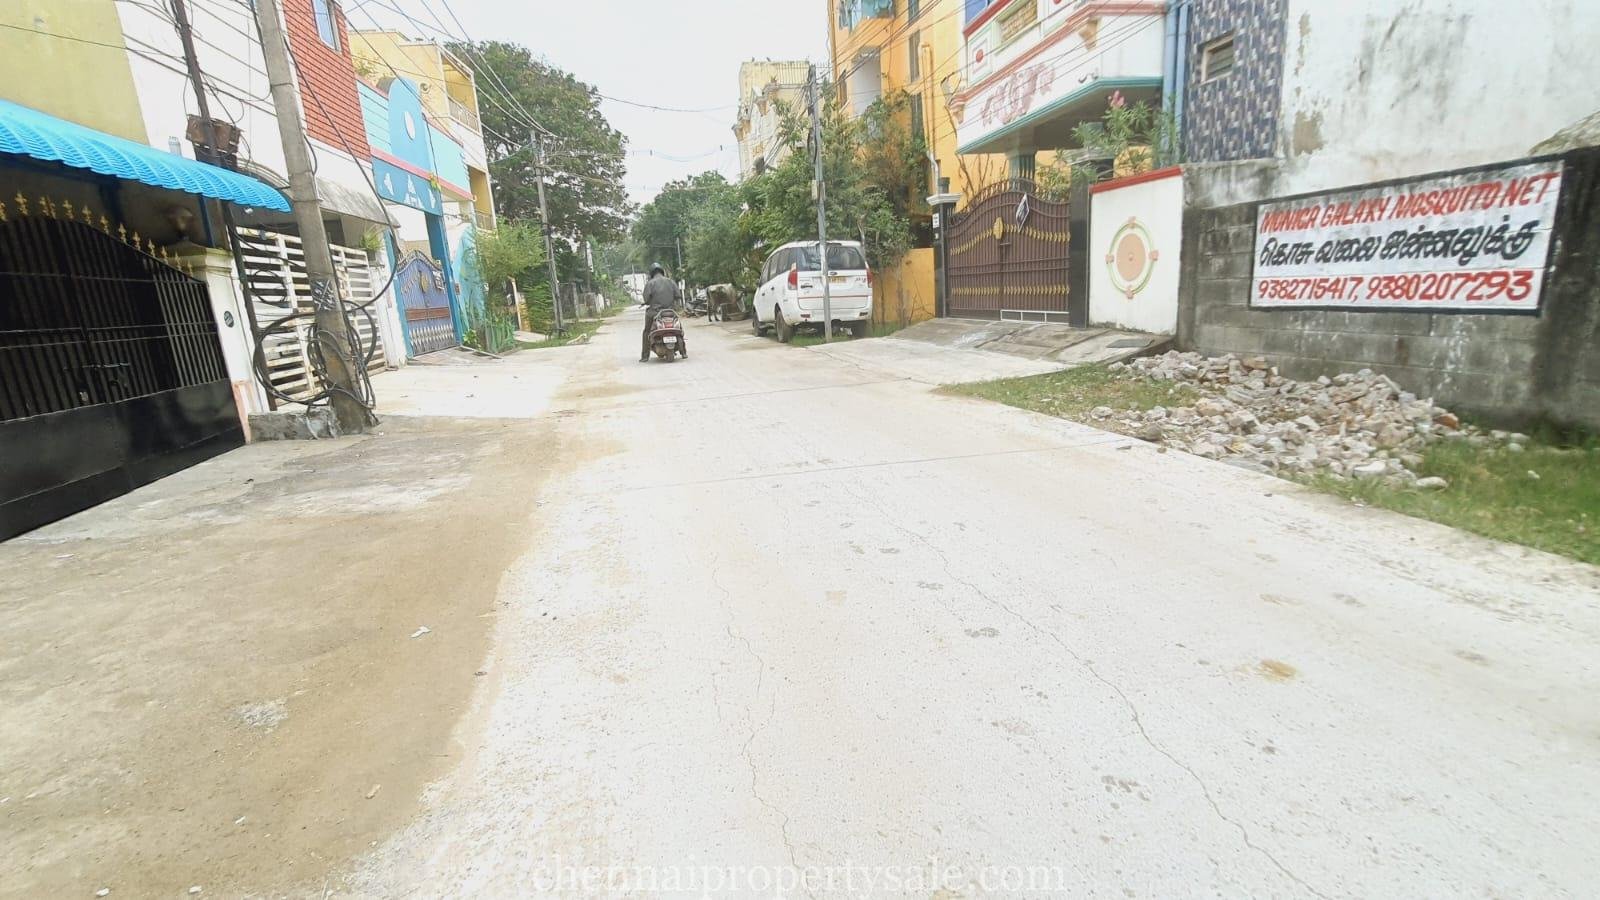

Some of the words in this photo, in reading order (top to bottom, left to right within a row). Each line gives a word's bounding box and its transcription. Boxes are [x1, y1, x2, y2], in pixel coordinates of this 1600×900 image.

[1261, 205, 1319, 233] MONICA
[1320, 197, 1390, 227] GALAXY
[1389, 182, 1503, 219] MOSQUITO
[1501, 172, 1560, 208] NET
[1258, 276, 1364, 303] 9382715417,
[1366, 270, 1534, 301] 9380207293
